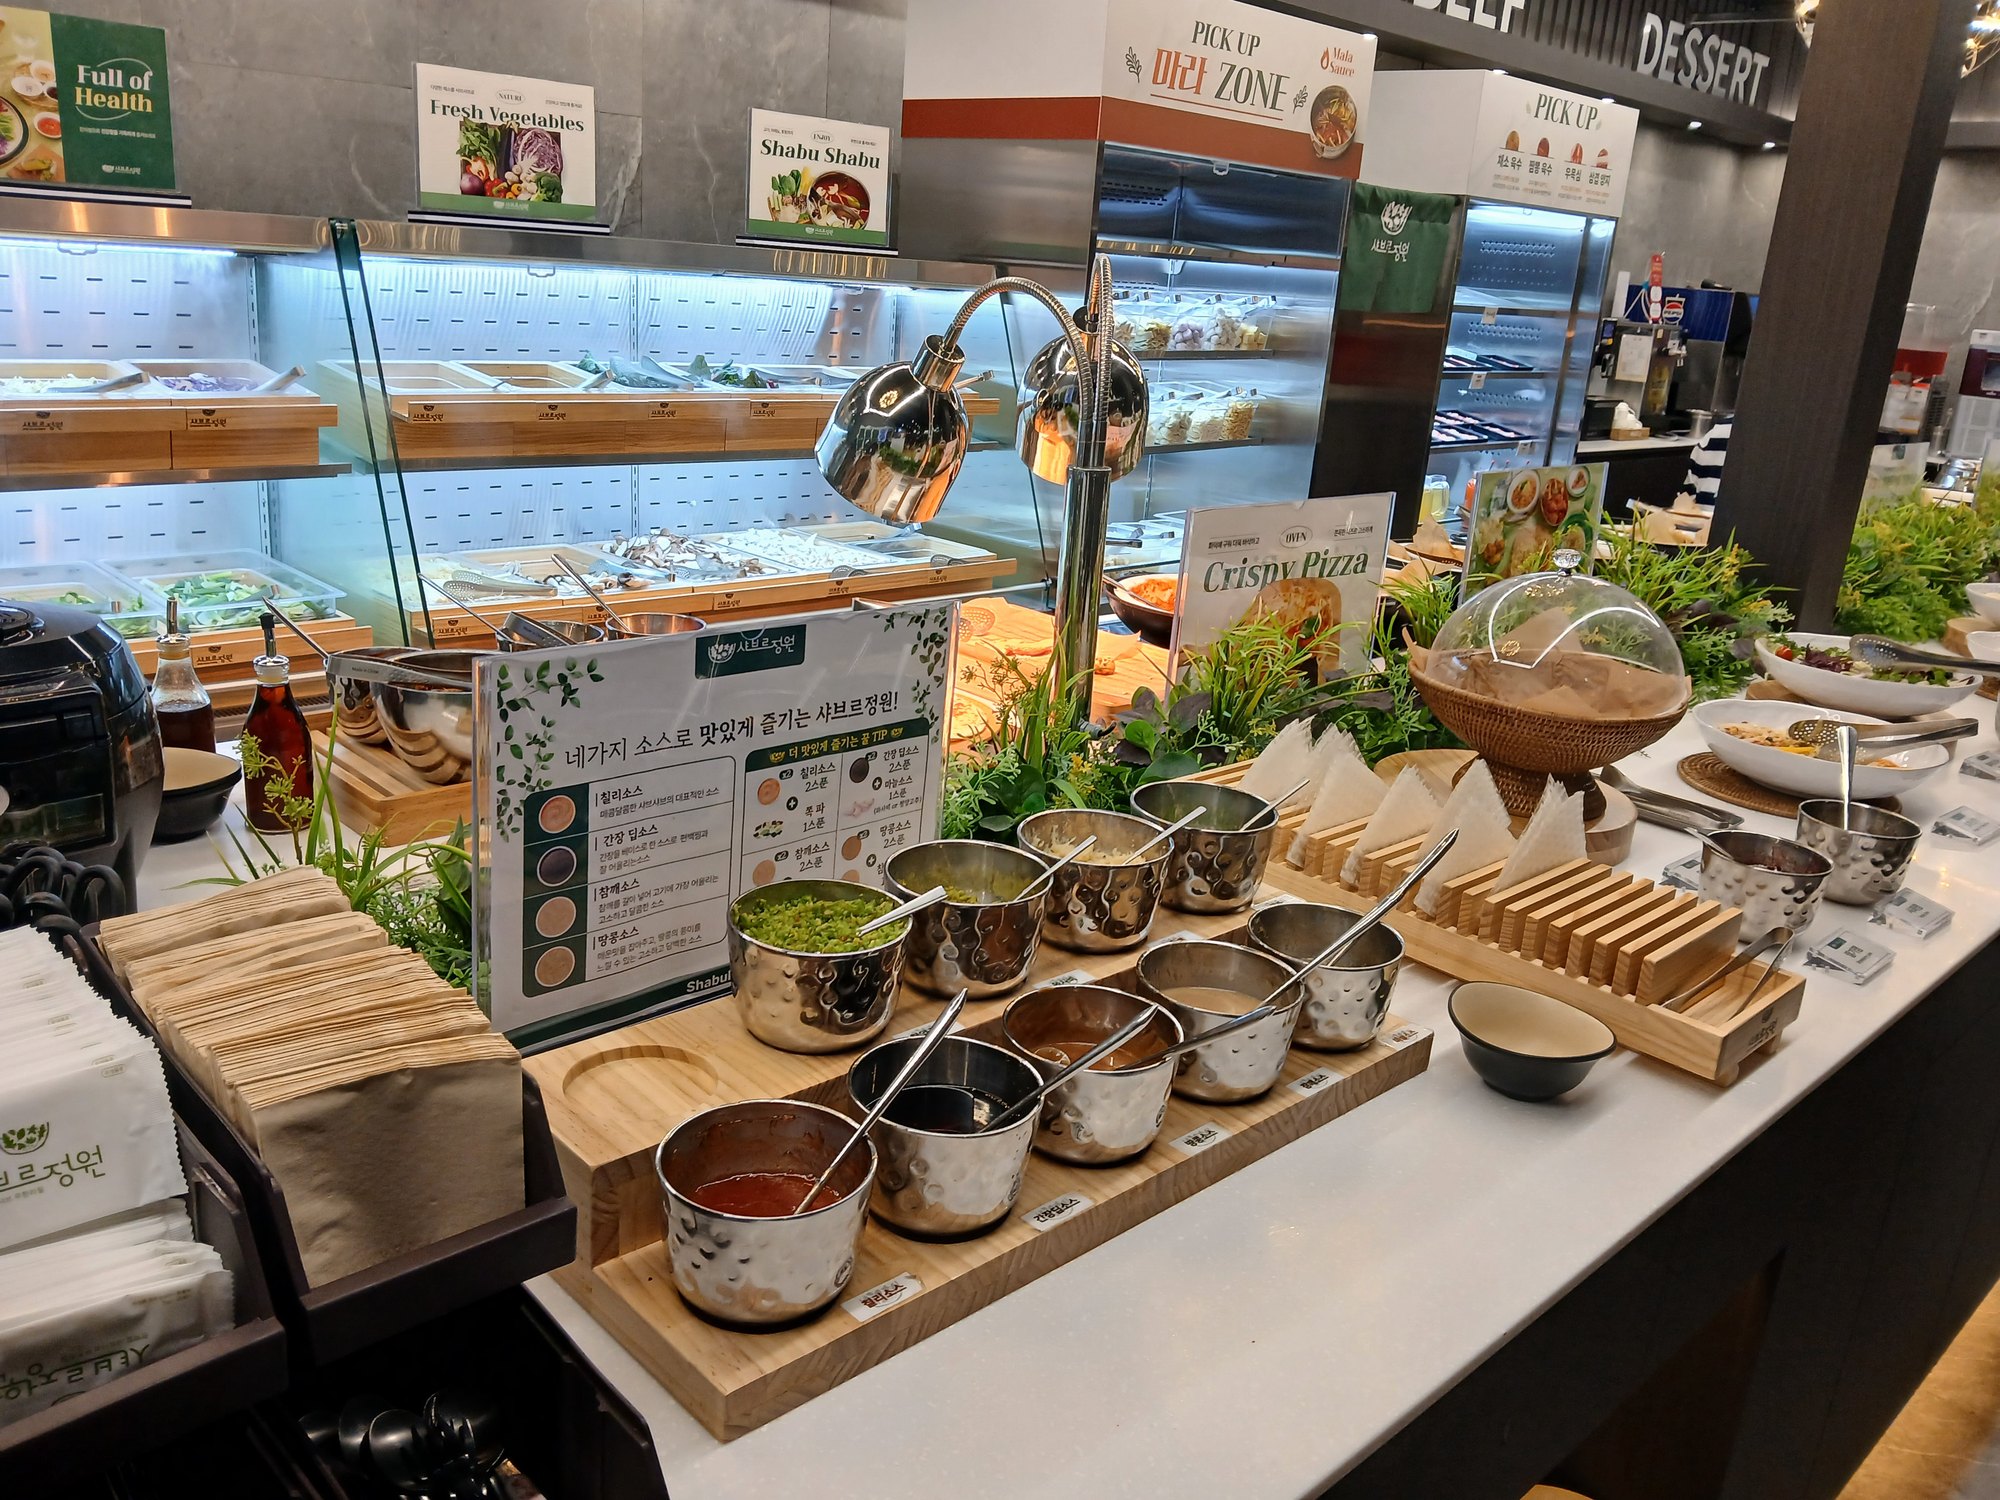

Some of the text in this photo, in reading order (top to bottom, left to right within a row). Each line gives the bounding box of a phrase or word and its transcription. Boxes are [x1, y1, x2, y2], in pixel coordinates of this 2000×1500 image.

[1191, 20, 1261, 57] PICK UP
[1331, 47, 1354, 63] Mala
[1635, 11, 1771, 108] DESSERT
[77, 64, 154, 91] Full of
[1151, 48, 1290, 111] 마라 ZONE
[1329, 60, 1355, 77] Sauce
[75, 86, 153, 113] Health
[430, 99, 585, 132] Fresh Vegetables
[1533, 93, 1598, 130] PICK UP
[760, 139, 880, 169] Shabu Shabu
[1370, 239, 1410, 262] 샤브르정원
[1285, 530, 1307, 544] OVEN
[1203, 548, 1369, 593] Crispy Pizza
[735, 634, 796, 655] 샤브르정원
[565, 690, 899, 769] 네가지 소스로 맛있게 즐기는 샤브르정원!
[789, 748, 798, 758] 더
[801, 741, 828, 757] 맛있게
[831, 736, 857, 751] 즐기는
[872, 729, 888, 742] TIP
[883, 745, 919, 761] 간장 딥소스
[800, 761, 836, 779] 칠리소스
[888, 758, 911, 773] 2스푼
[600, 785, 643, 805] 칠리소스
[805, 777, 829, 792] 2스푼
[889, 787, 907, 801] 1스푼
[599, 786, 719, 818] 매콤달콤한 샤브샤브의 대표적인 소스
[603, 824, 659, 847] 간장 딥소스
[803, 817, 826, 832] 1스푼
[879, 819, 912, 838] 땅콩소스
[599, 849, 620, 863] 간장을
[621, 842, 648, 855] 베이스로
[648, 840, 656, 850] 한
[657, 835, 678, 847] 소스로
[794, 841, 830, 860] 참깨소스
[883, 834, 905, 849] 2스푼
[599, 864, 607, 875] 잘
[799, 856, 823, 872] 2스푼
[598, 878, 640, 899] 참깨소스
[599, 898, 620, 913] 참깨를
[652, 884, 674, 898] 고기에
[675, 880, 690, 892] 가장
[690, 875, 719, 887] 어울리는
[598, 899, 664, 924] 고소하고 달콤한 소스
[597, 926, 639, 948] 땅콩소스
[614, 959, 621, 968] 수
[638, 944, 664, 960] 고소하고
[688, 935, 702, 944] 소스
[1033, 1197, 1081, 1224] 간장딥소스
[860, 1283, 907, 1309] 칠리소스
